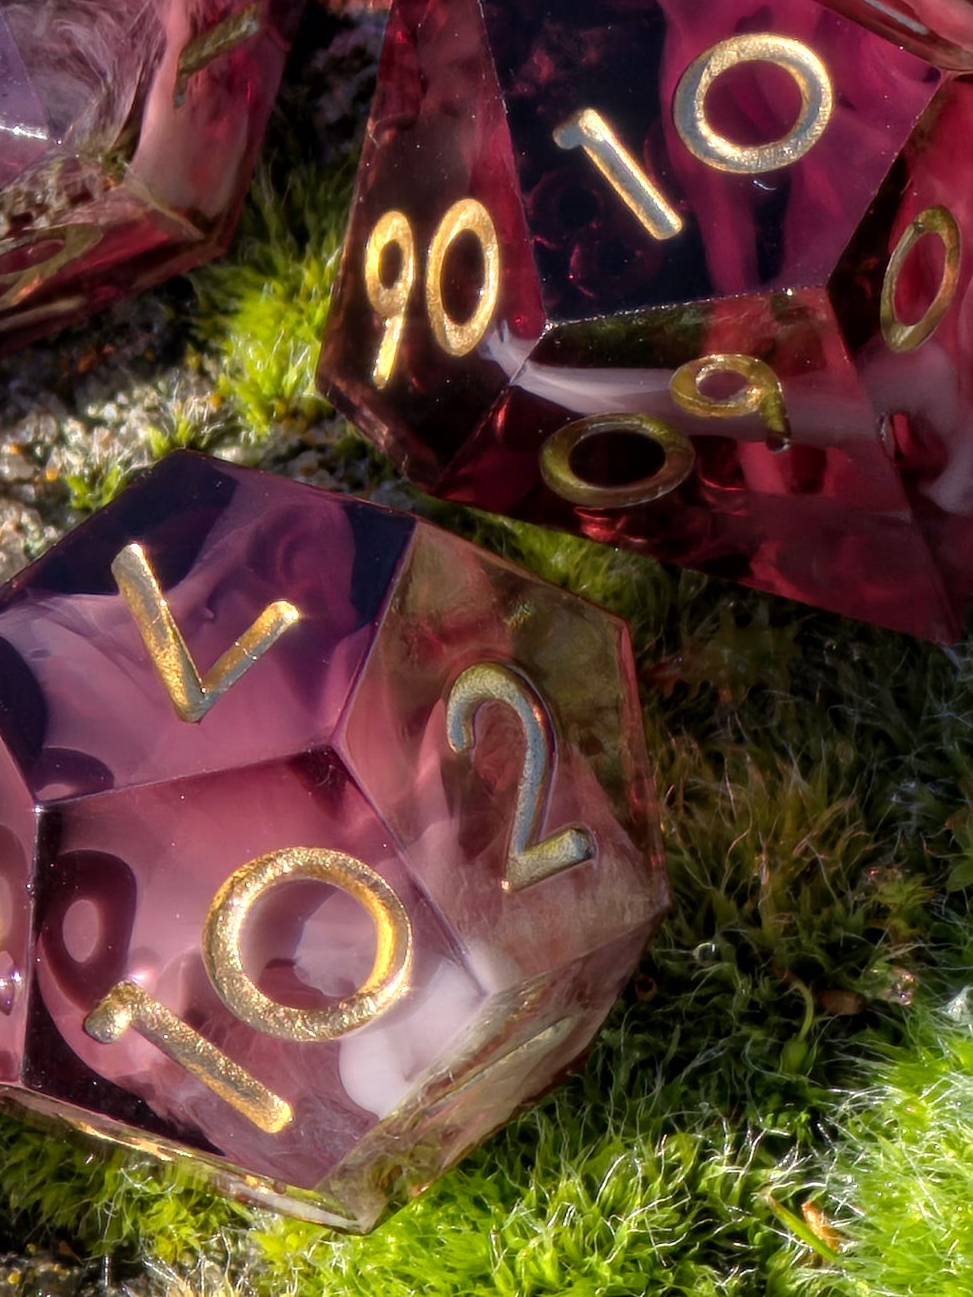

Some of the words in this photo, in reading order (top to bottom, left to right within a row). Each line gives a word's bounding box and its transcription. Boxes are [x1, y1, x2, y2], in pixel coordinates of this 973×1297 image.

[553, 33, 834, 240] 10
[365, 199, 500, 390] 90
[110, 542, 301, 724] 7
[446, 662, 597, 893] 2
[84, 846, 414, 1135] 10
